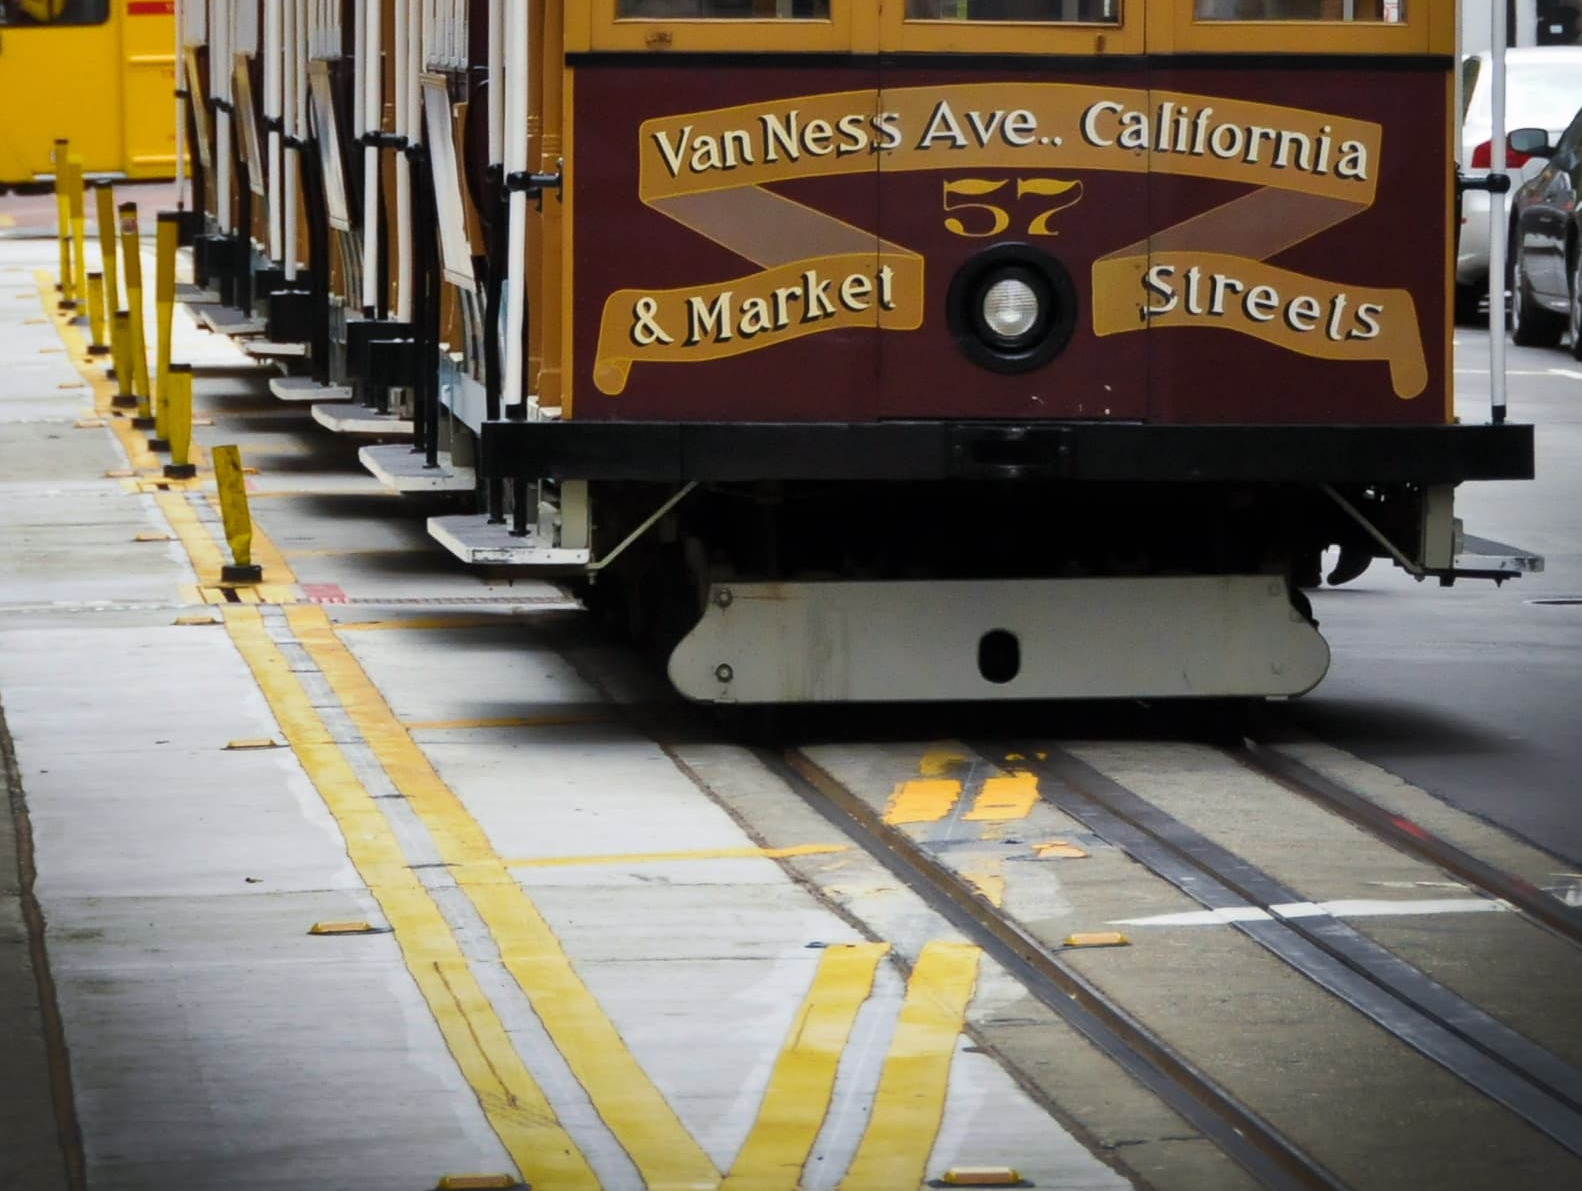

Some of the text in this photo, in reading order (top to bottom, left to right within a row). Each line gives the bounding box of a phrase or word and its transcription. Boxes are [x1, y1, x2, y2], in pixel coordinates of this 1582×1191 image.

[652, 124, 755, 179] Van
[759, 109, 903, 160] Ness
[1081, 100, 1370, 180] California
[943, 177, 1084, 238] 57
[630, 263, 1385, 346] & Market Streets
